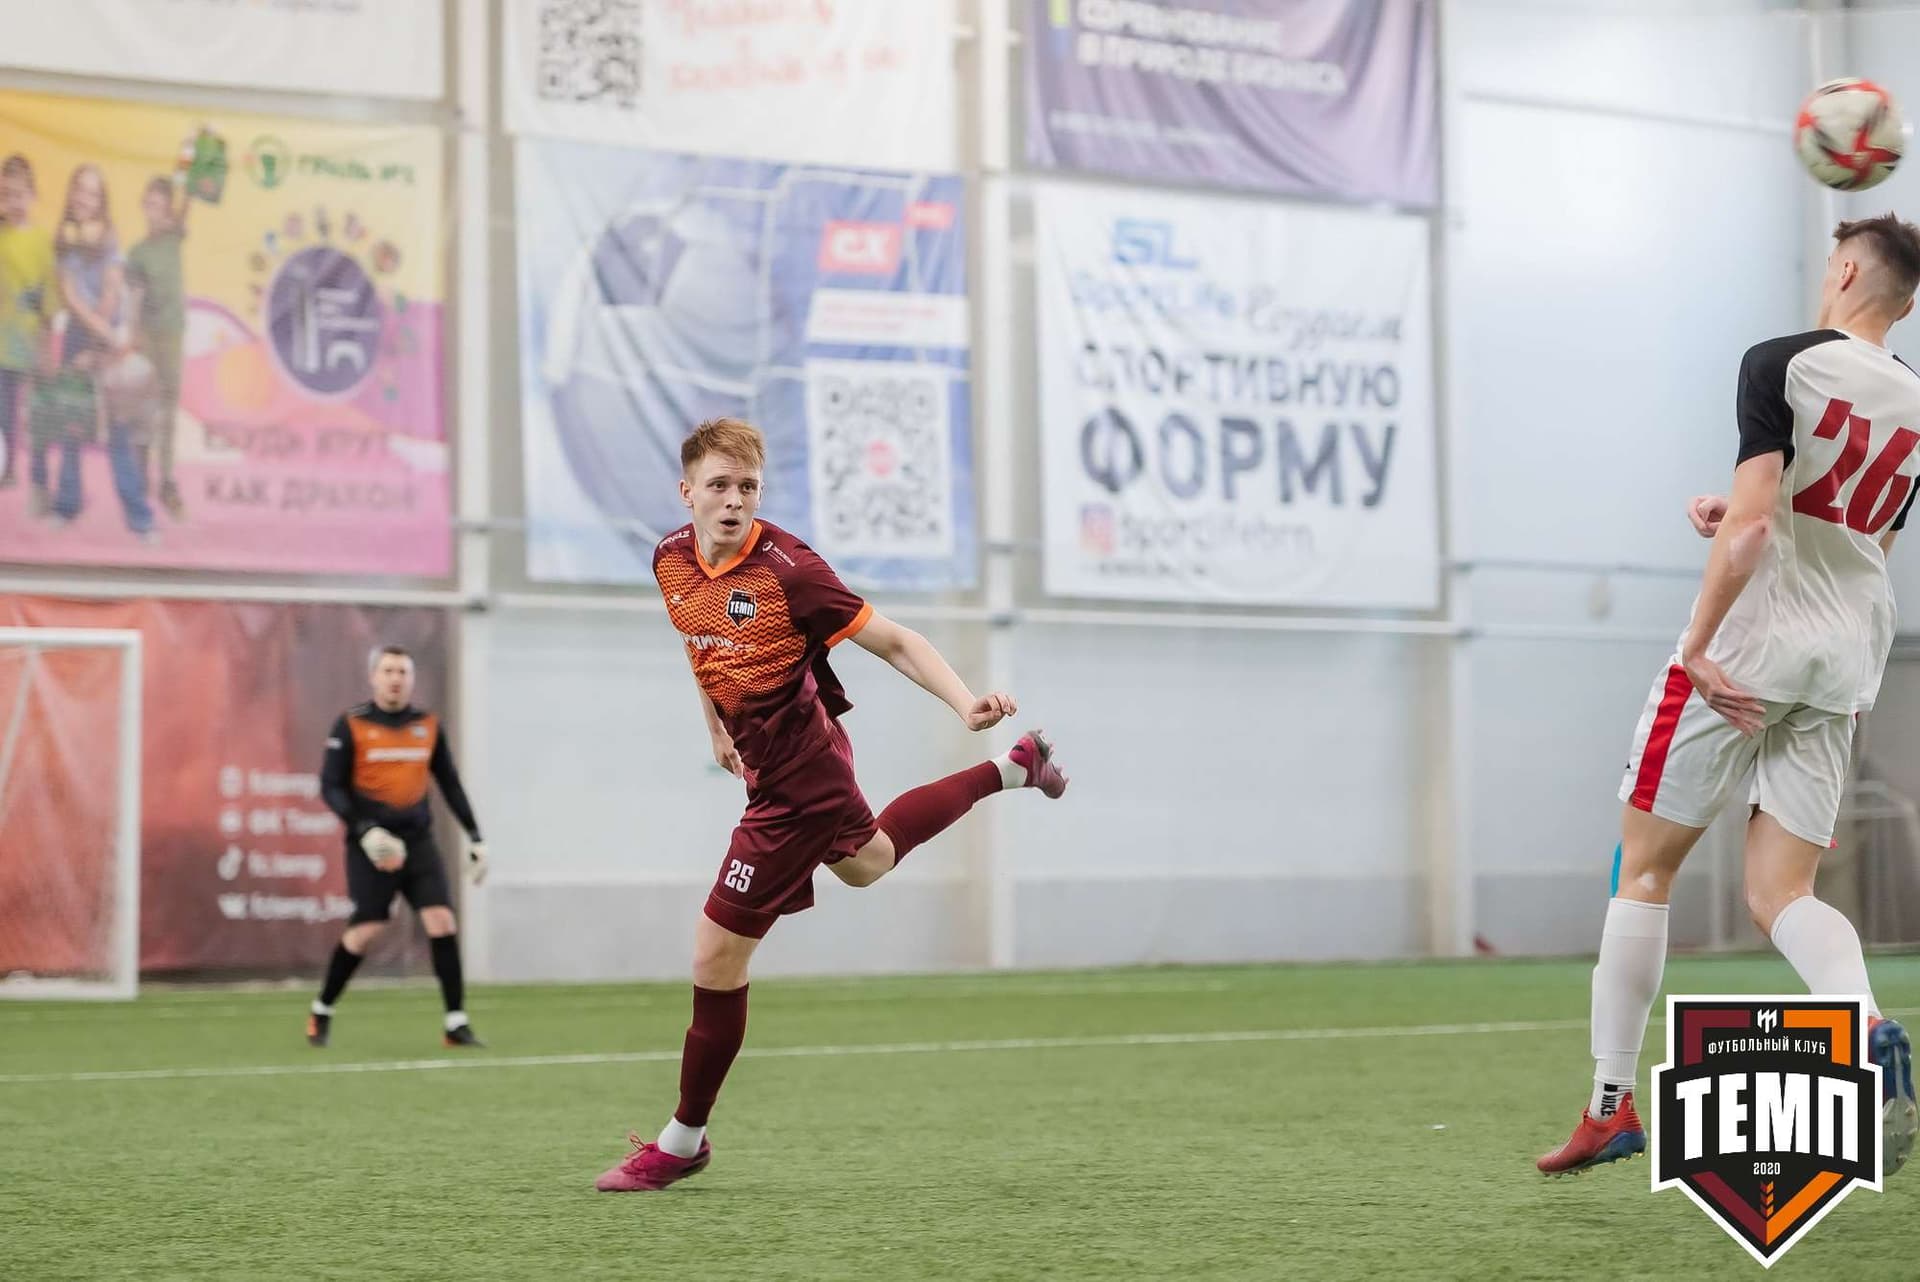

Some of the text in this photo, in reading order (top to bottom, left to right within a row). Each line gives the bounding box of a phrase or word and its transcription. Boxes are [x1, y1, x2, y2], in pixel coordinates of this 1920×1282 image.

[1078, 32, 1101, 65] В
[1077, 342, 1401, 408] СПОРТИВНУЮ
[1080, 405, 1396, 509] ФОРМУ
[1792, 397, 1920, 535] 26
[204, 474, 268, 505] КАК
[729, 600, 755, 618] ТЕМП
[724, 858, 756, 893] 25
[1601, 1094, 1617, 1116] NIKE
